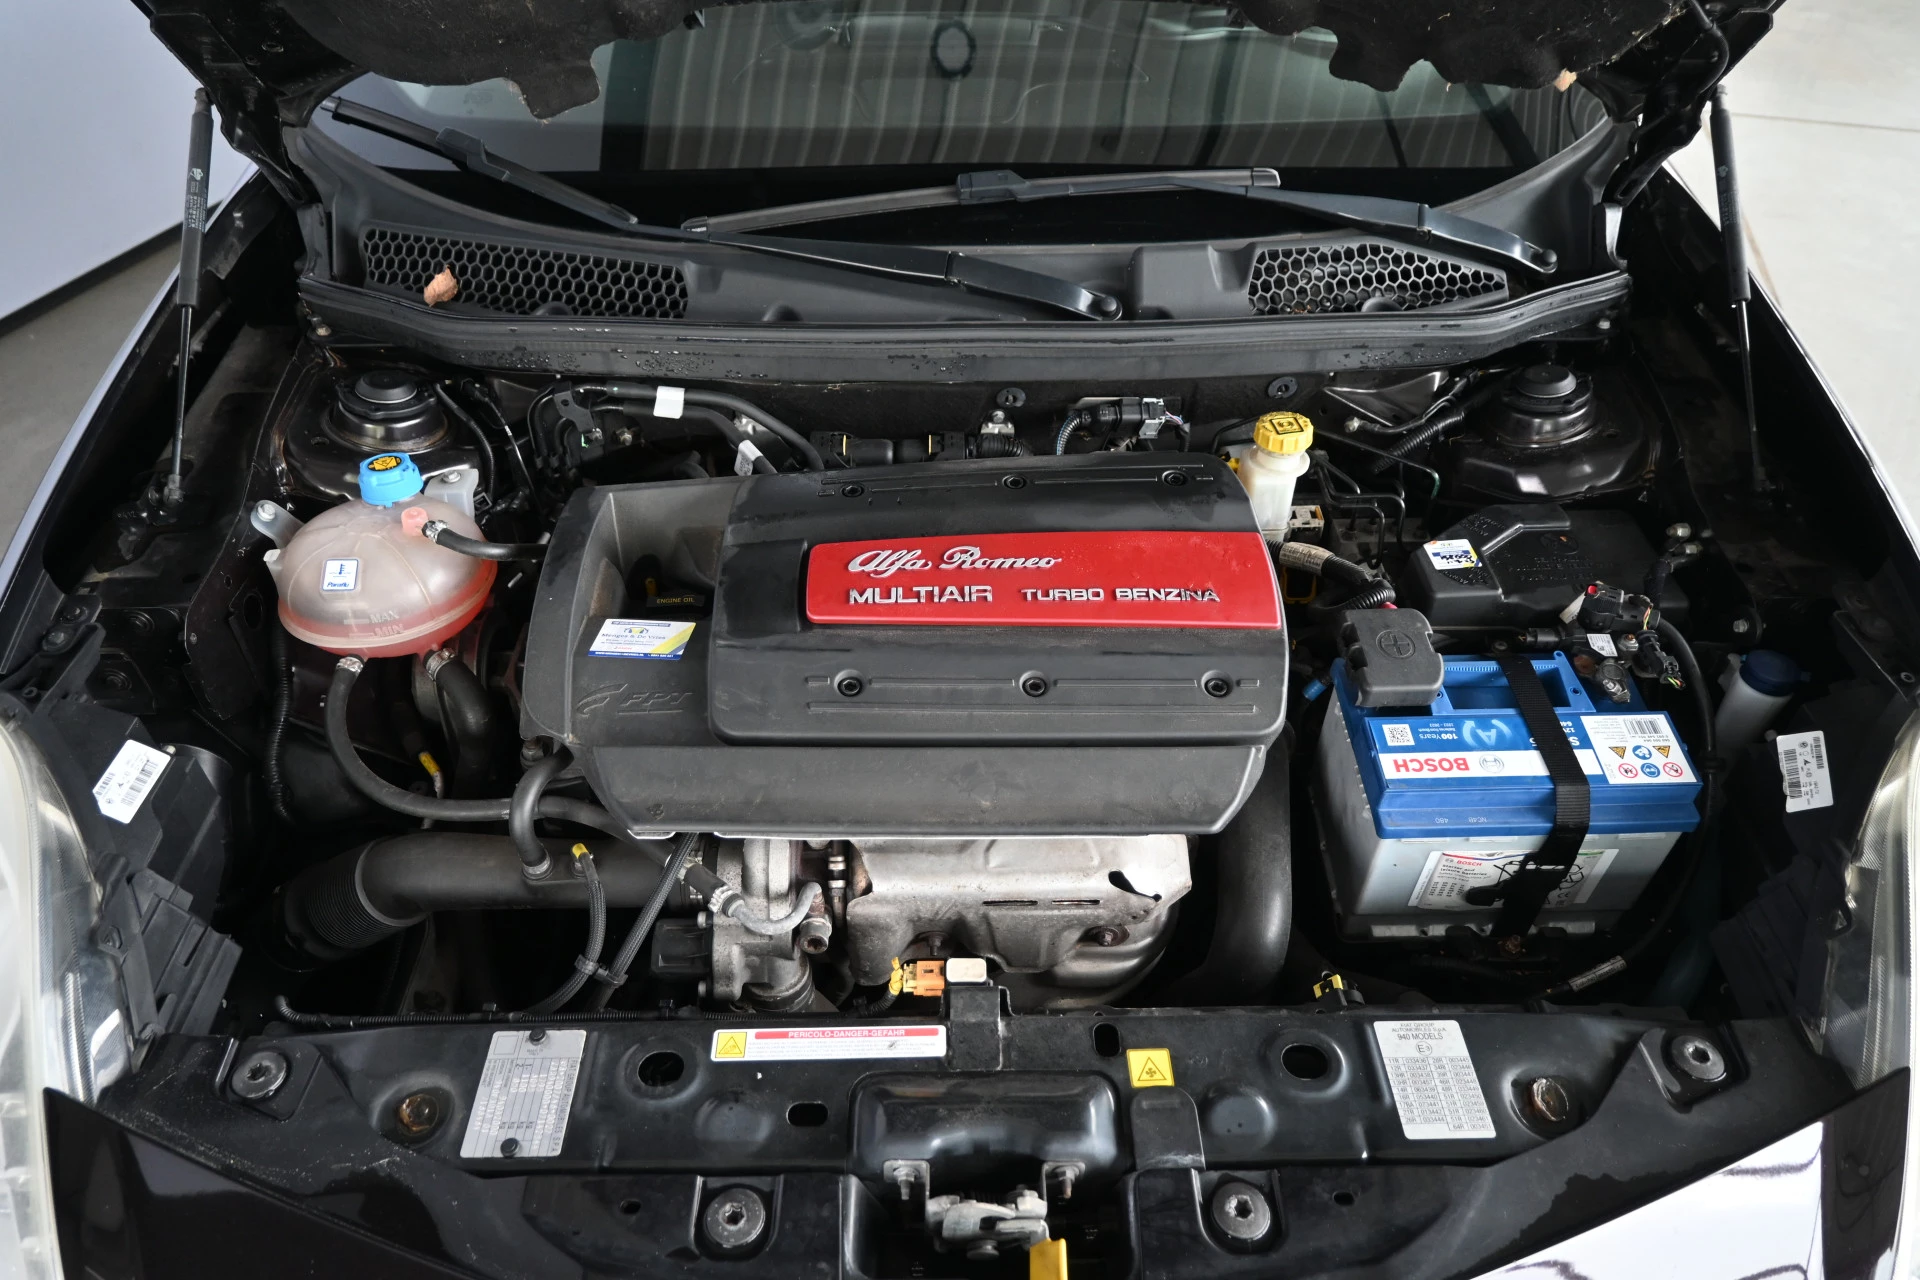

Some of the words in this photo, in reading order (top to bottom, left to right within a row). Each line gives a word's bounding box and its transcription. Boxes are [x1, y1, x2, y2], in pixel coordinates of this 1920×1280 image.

[847, 549, 932, 578] Alfa
[938, 545, 1062, 571] Romeo
[849, 585, 993, 605] MULTIAIR
[1020, 588, 1105, 602] TURBO
[1114, 587, 1221, 603] BENZINA
[369, 610, 400, 623] MAX
[374, 623, 404, 637] MIN
[1393, 757, 1470, 773] BOSCH
[788, 1029, 906, 1038] PERICOLO-DANGER-GEFAHR
[1412, 1032, 1444, 1040] MODELS
[565, 1072, 575, 1092] GROUP
[554, 1093, 570, 1133] AUTOMOBILES
